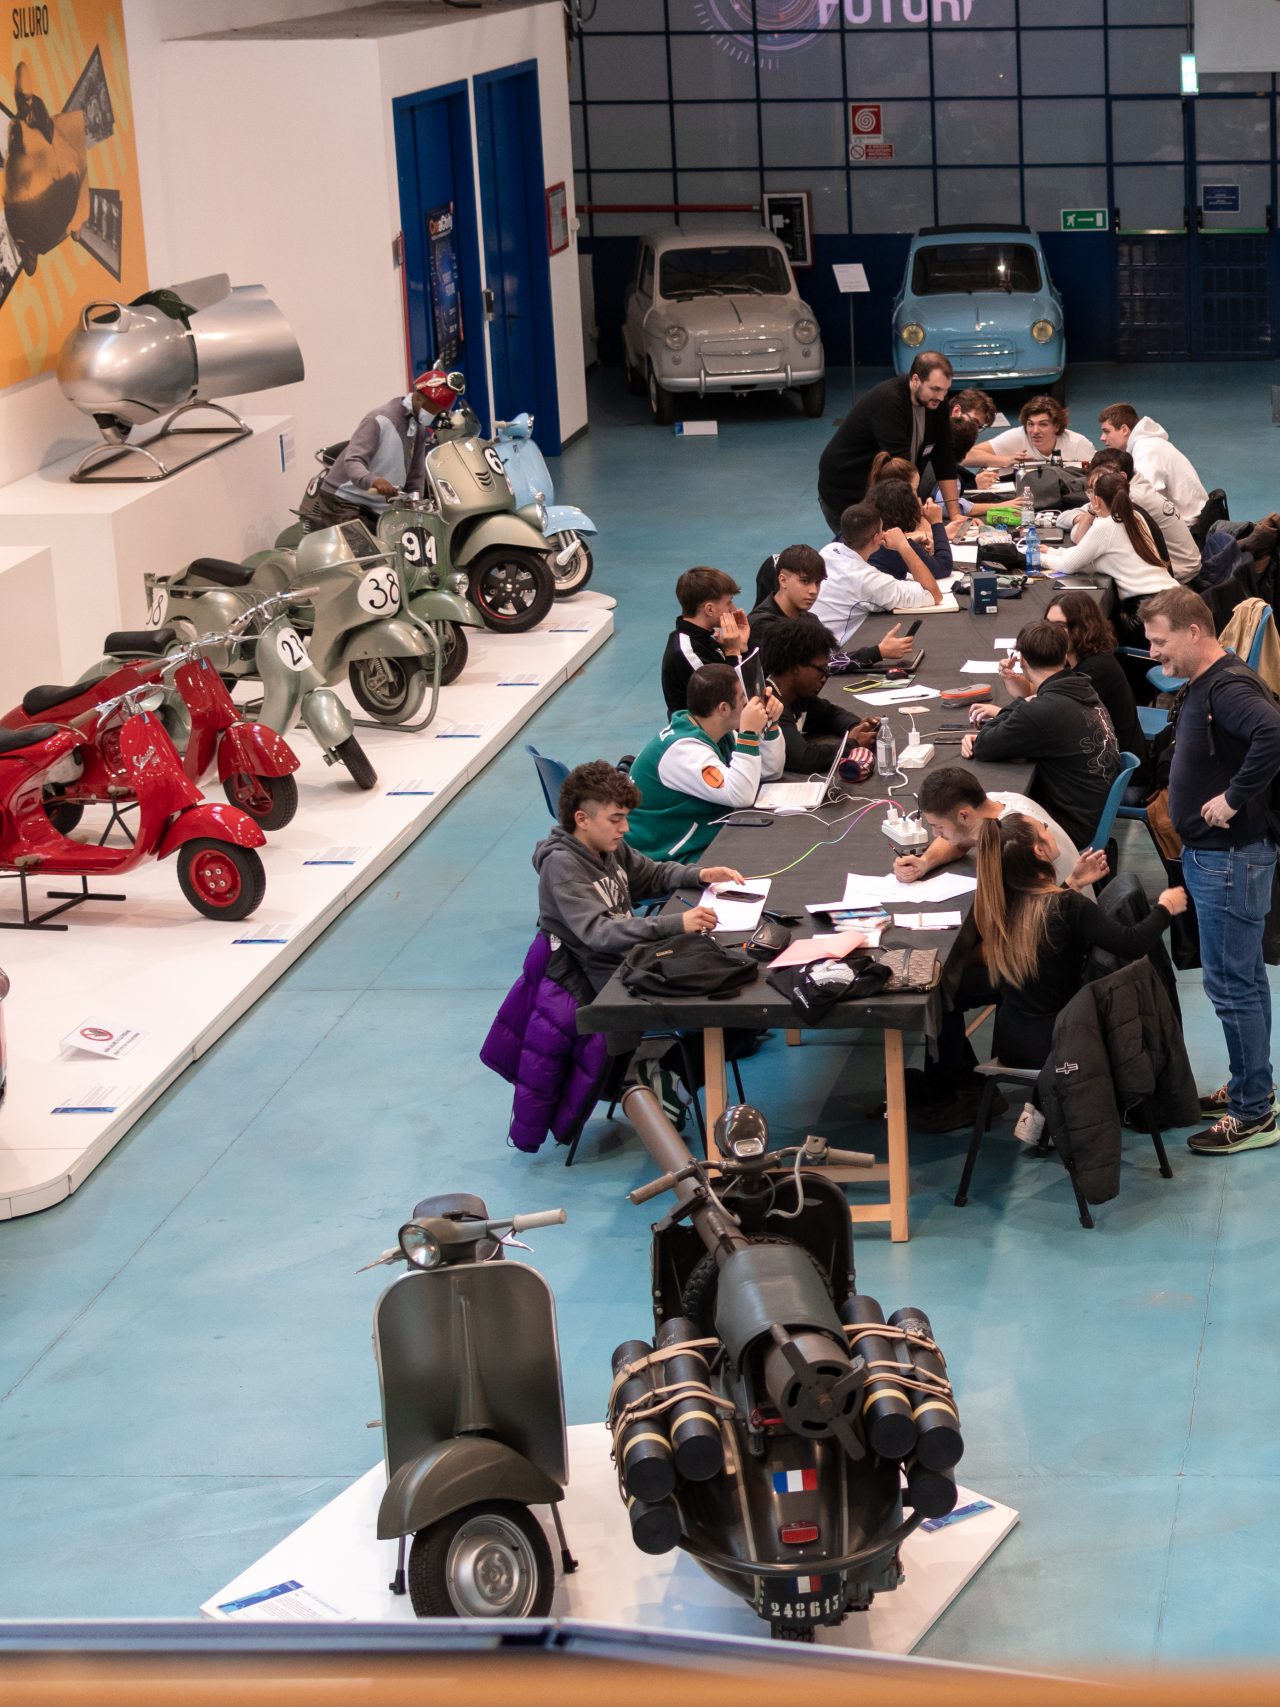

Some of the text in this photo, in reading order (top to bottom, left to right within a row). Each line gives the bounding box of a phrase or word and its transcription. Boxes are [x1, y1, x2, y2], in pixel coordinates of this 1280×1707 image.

[12, 4, 49, 39] SILURO
[402, 531, 438, 566] 94
[368, 573, 400, 609] 38
[770, 1594, 840, 1618] 248615
